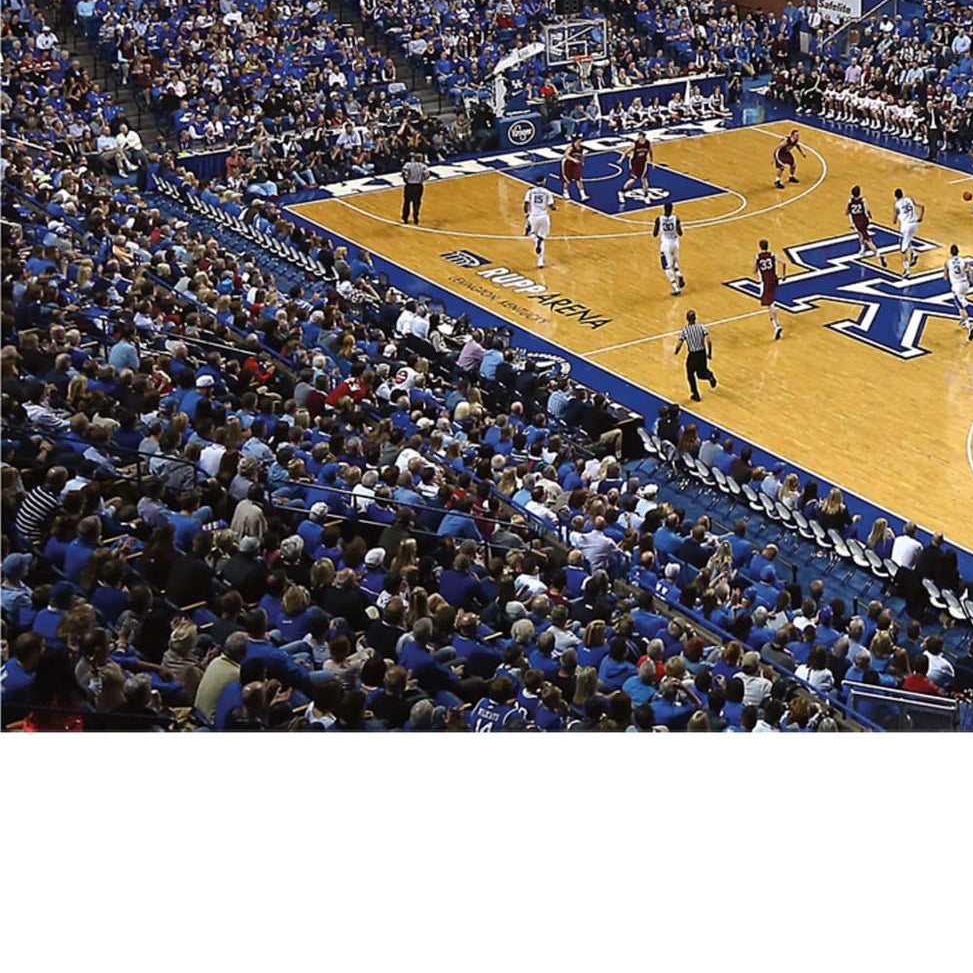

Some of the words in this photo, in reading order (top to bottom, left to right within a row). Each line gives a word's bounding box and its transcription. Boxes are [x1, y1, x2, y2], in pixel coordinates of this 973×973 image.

[818, 0, 852, 15] Safelite
[533, 194, 543, 204] 15
[851, 204, 862, 214] 22
[760, 258, 773, 271] 33
[476, 266, 548, 294] RUPP
[528, 293, 612, 330] ARENA
